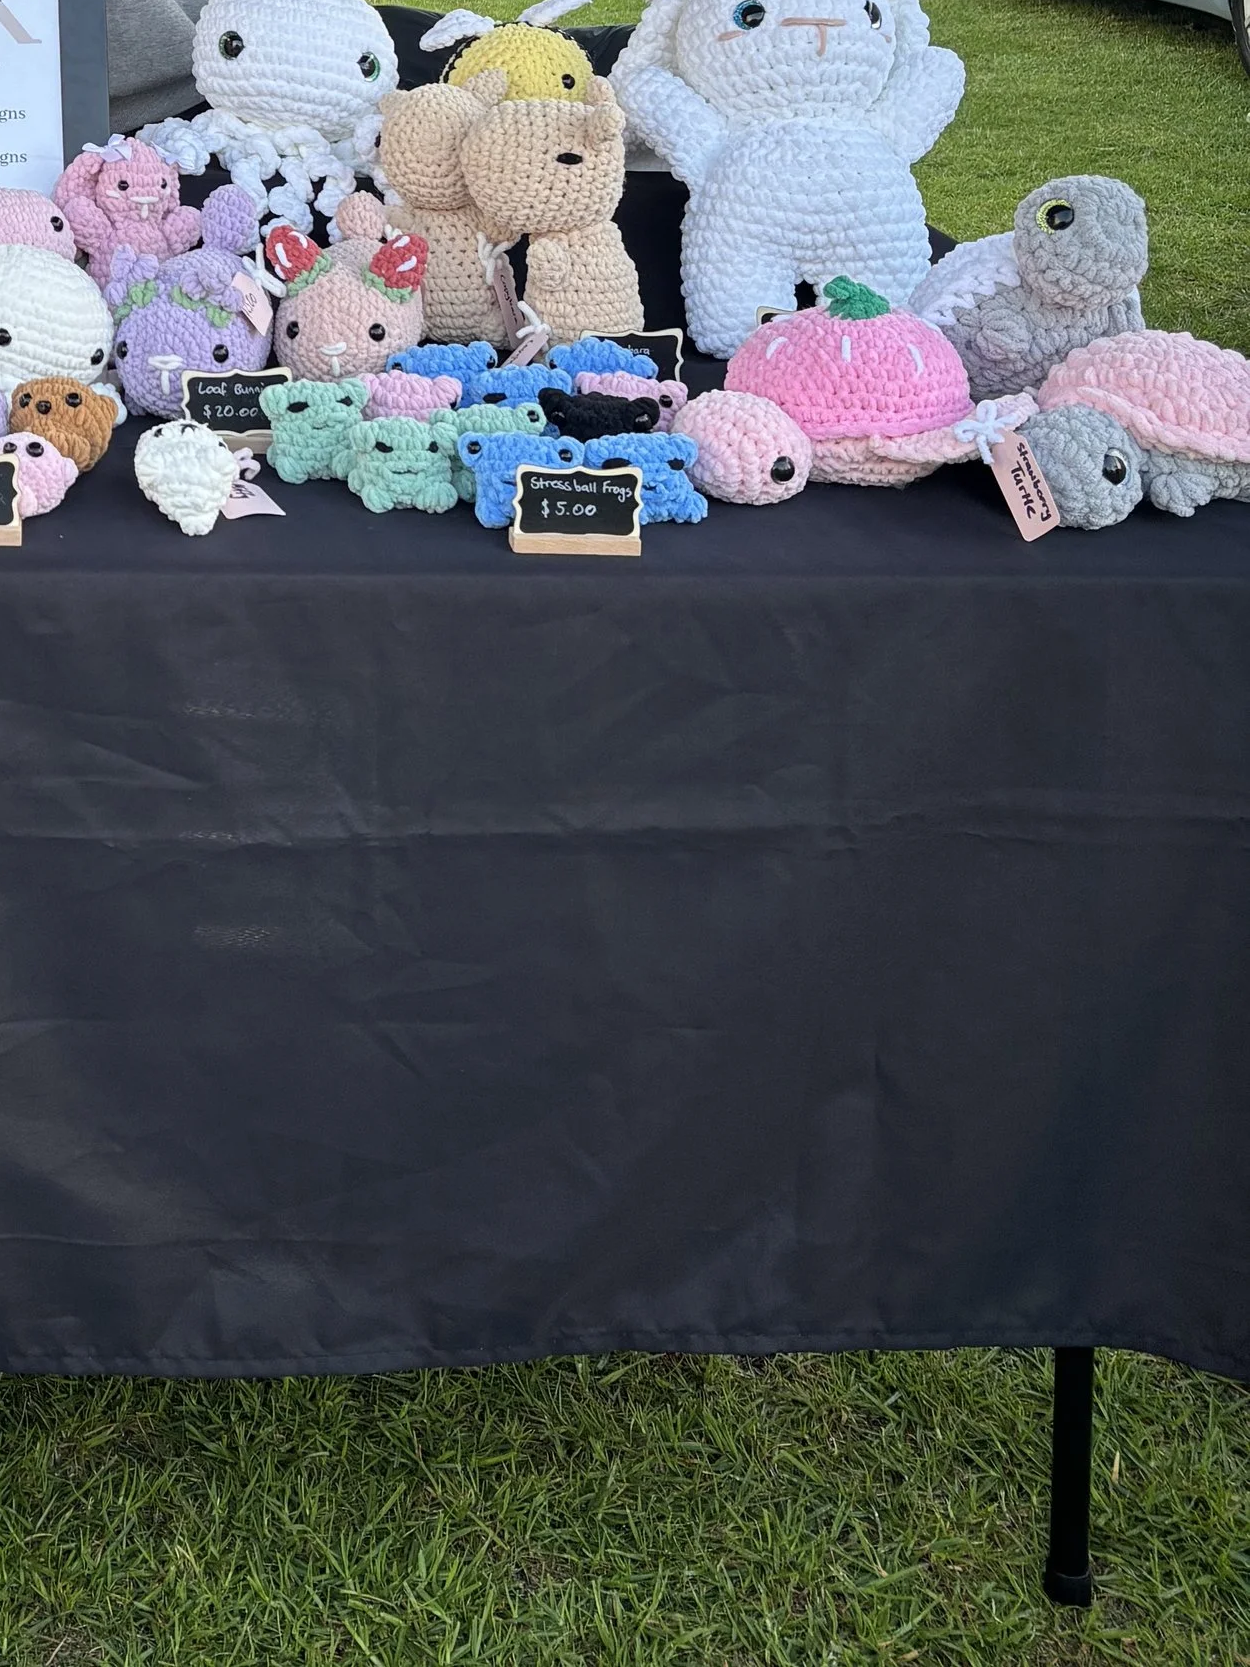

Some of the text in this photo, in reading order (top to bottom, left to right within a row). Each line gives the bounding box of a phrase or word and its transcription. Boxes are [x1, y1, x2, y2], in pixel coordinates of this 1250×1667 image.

[198, 382, 265, 396] Loaf Bunni
[602, 481, 632, 502] Frogs
